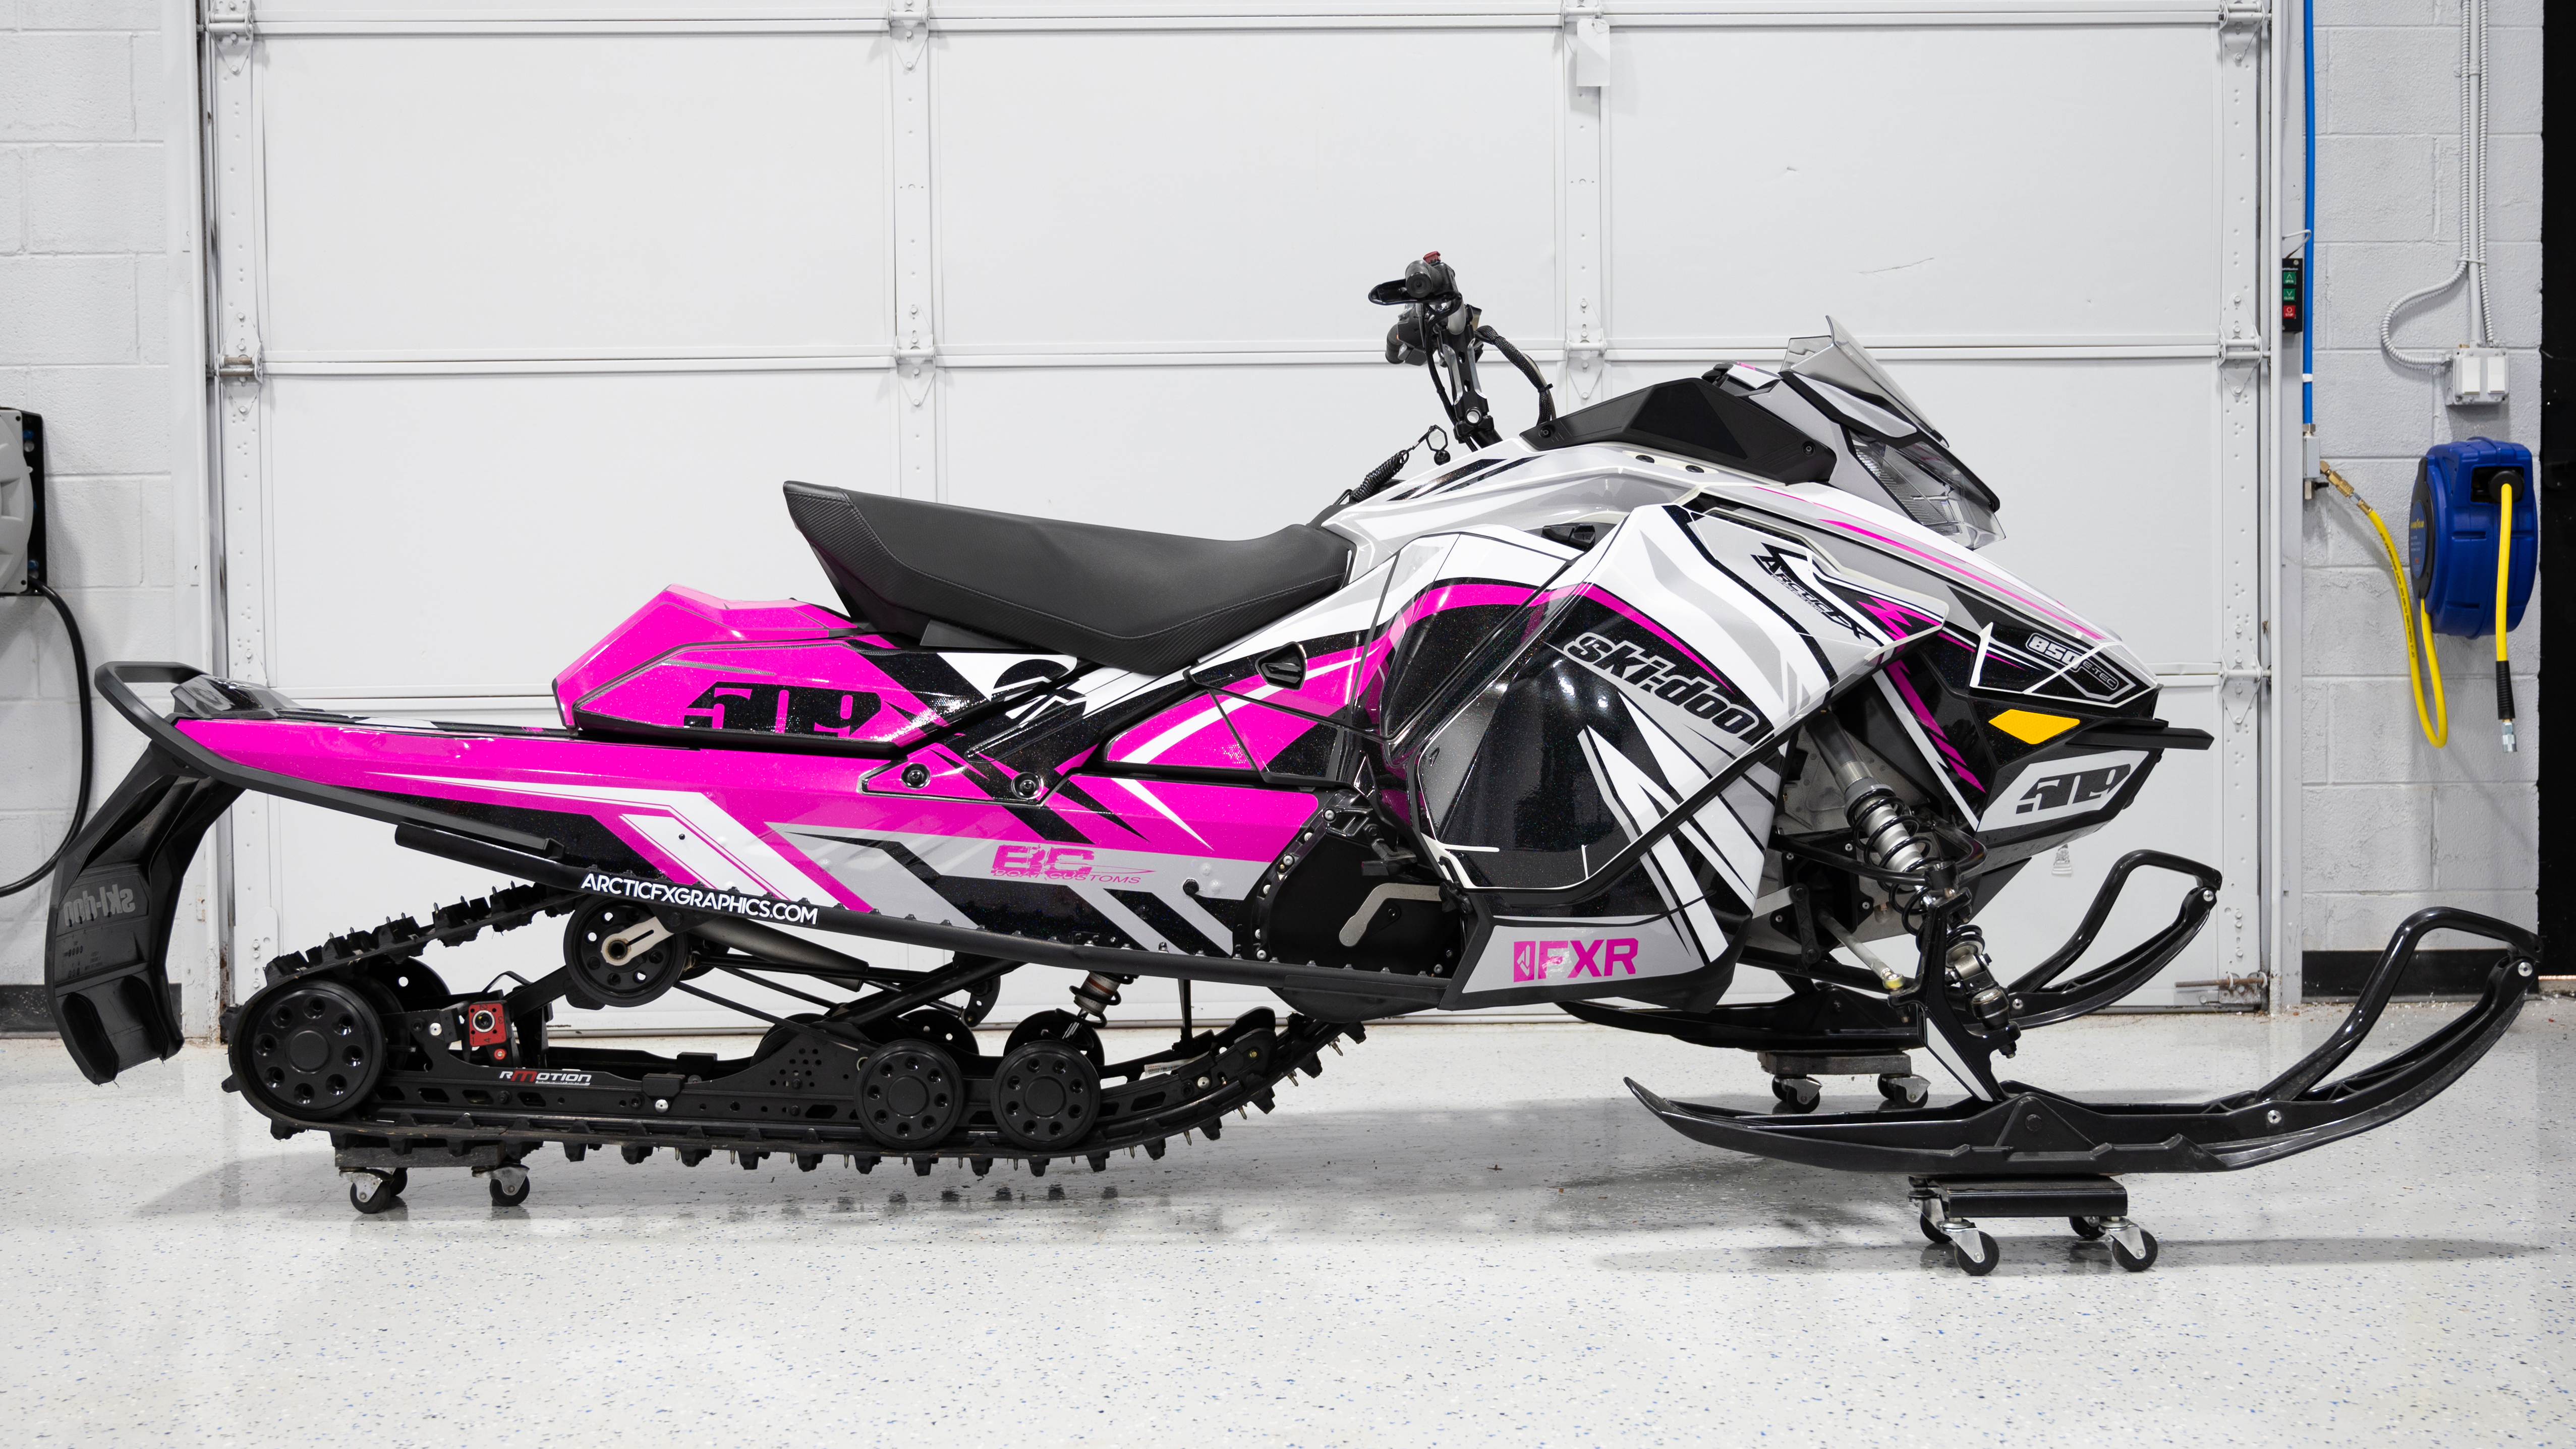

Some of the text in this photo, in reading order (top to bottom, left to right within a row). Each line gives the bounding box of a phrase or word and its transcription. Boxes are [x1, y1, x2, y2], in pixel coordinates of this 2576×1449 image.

[1567, 635, 1756, 735] ski-doo
[2028, 635, 2116, 688] 850 E-TEC
[580, 873, 819, 925] ARCTICFXGRAPHICS.COM
[1048, 872, 1141, 884] CUSTOMS
[1537, 938, 1639, 980] FXR
